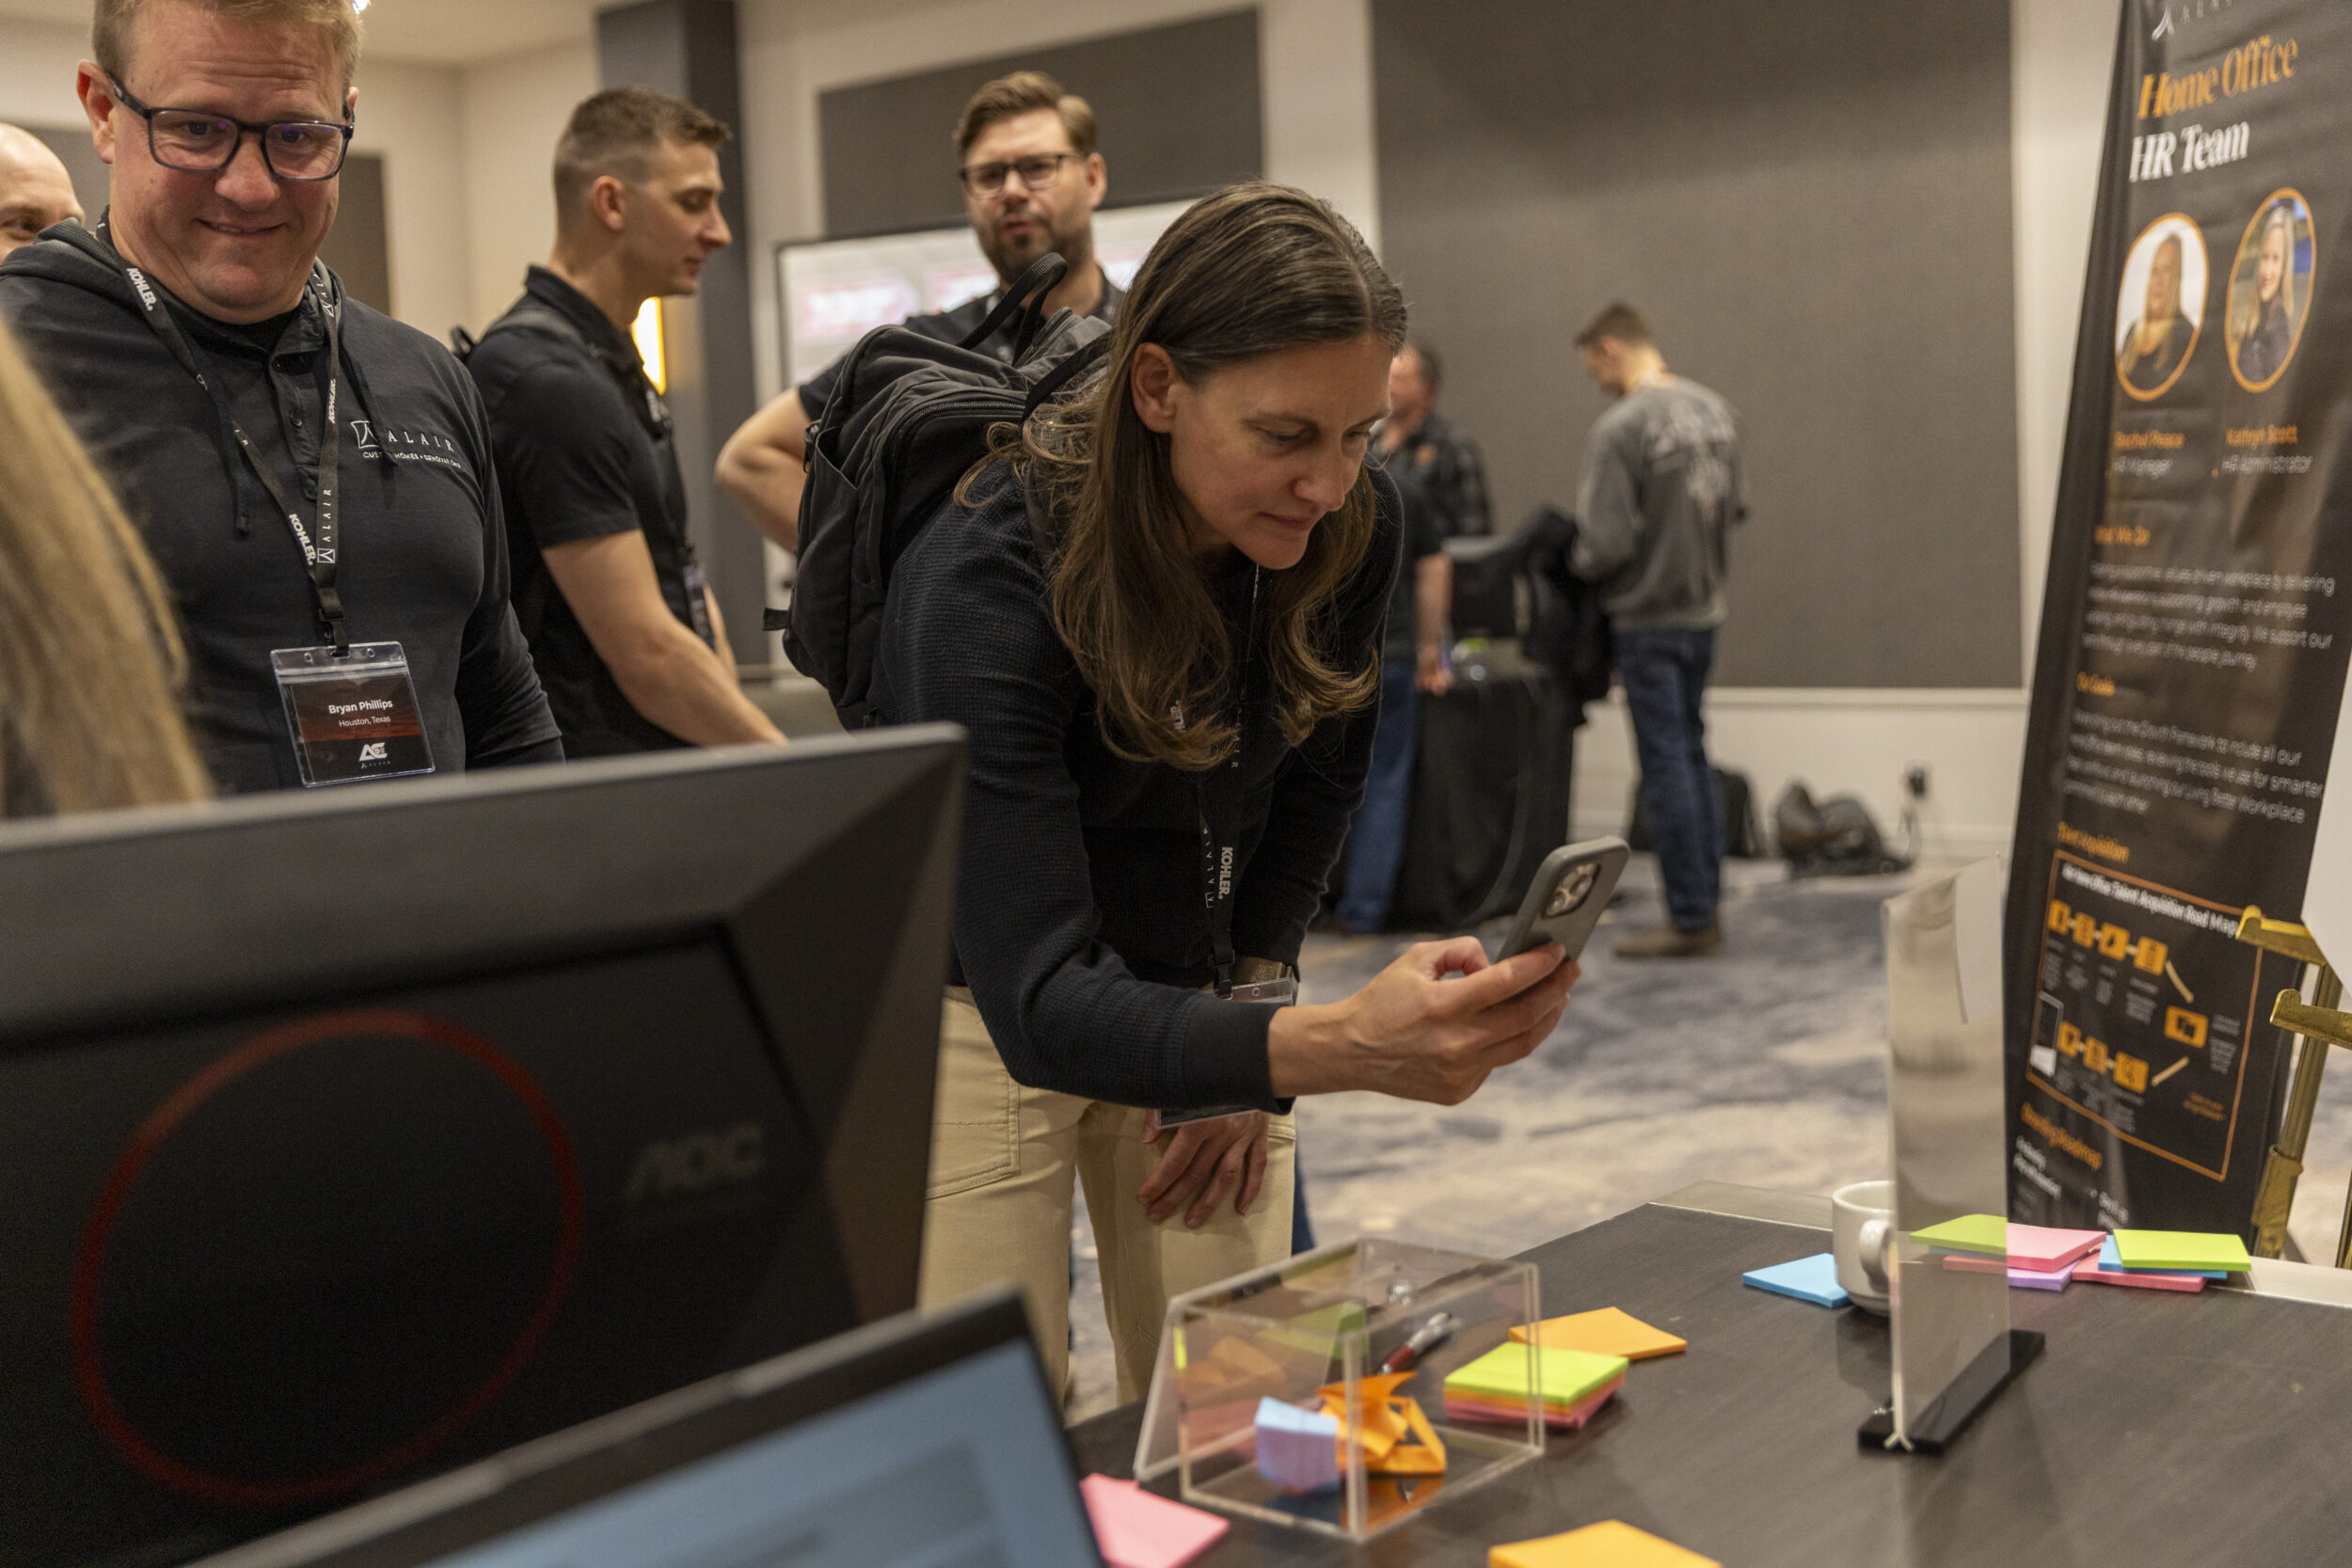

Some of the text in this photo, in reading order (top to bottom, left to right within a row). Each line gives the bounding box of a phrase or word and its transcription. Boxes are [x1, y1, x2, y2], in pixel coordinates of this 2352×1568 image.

[2137, 35, 2298, 119] Home Office
[2129, 121, 2250, 182] HR Team
[388, 430, 454, 452] ALAIR
[323, 489, 332, 543] ALAIR
[2308, 632, 2333, 649] our
[328, 699, 393, 715] Bryan Phillips
[339, 718, 372, 727] Houston,
[2277, 749, 2303, 767] our
[2269, 775, 2323, 799] smarter
[2209, 911, 2238, 939] Map
